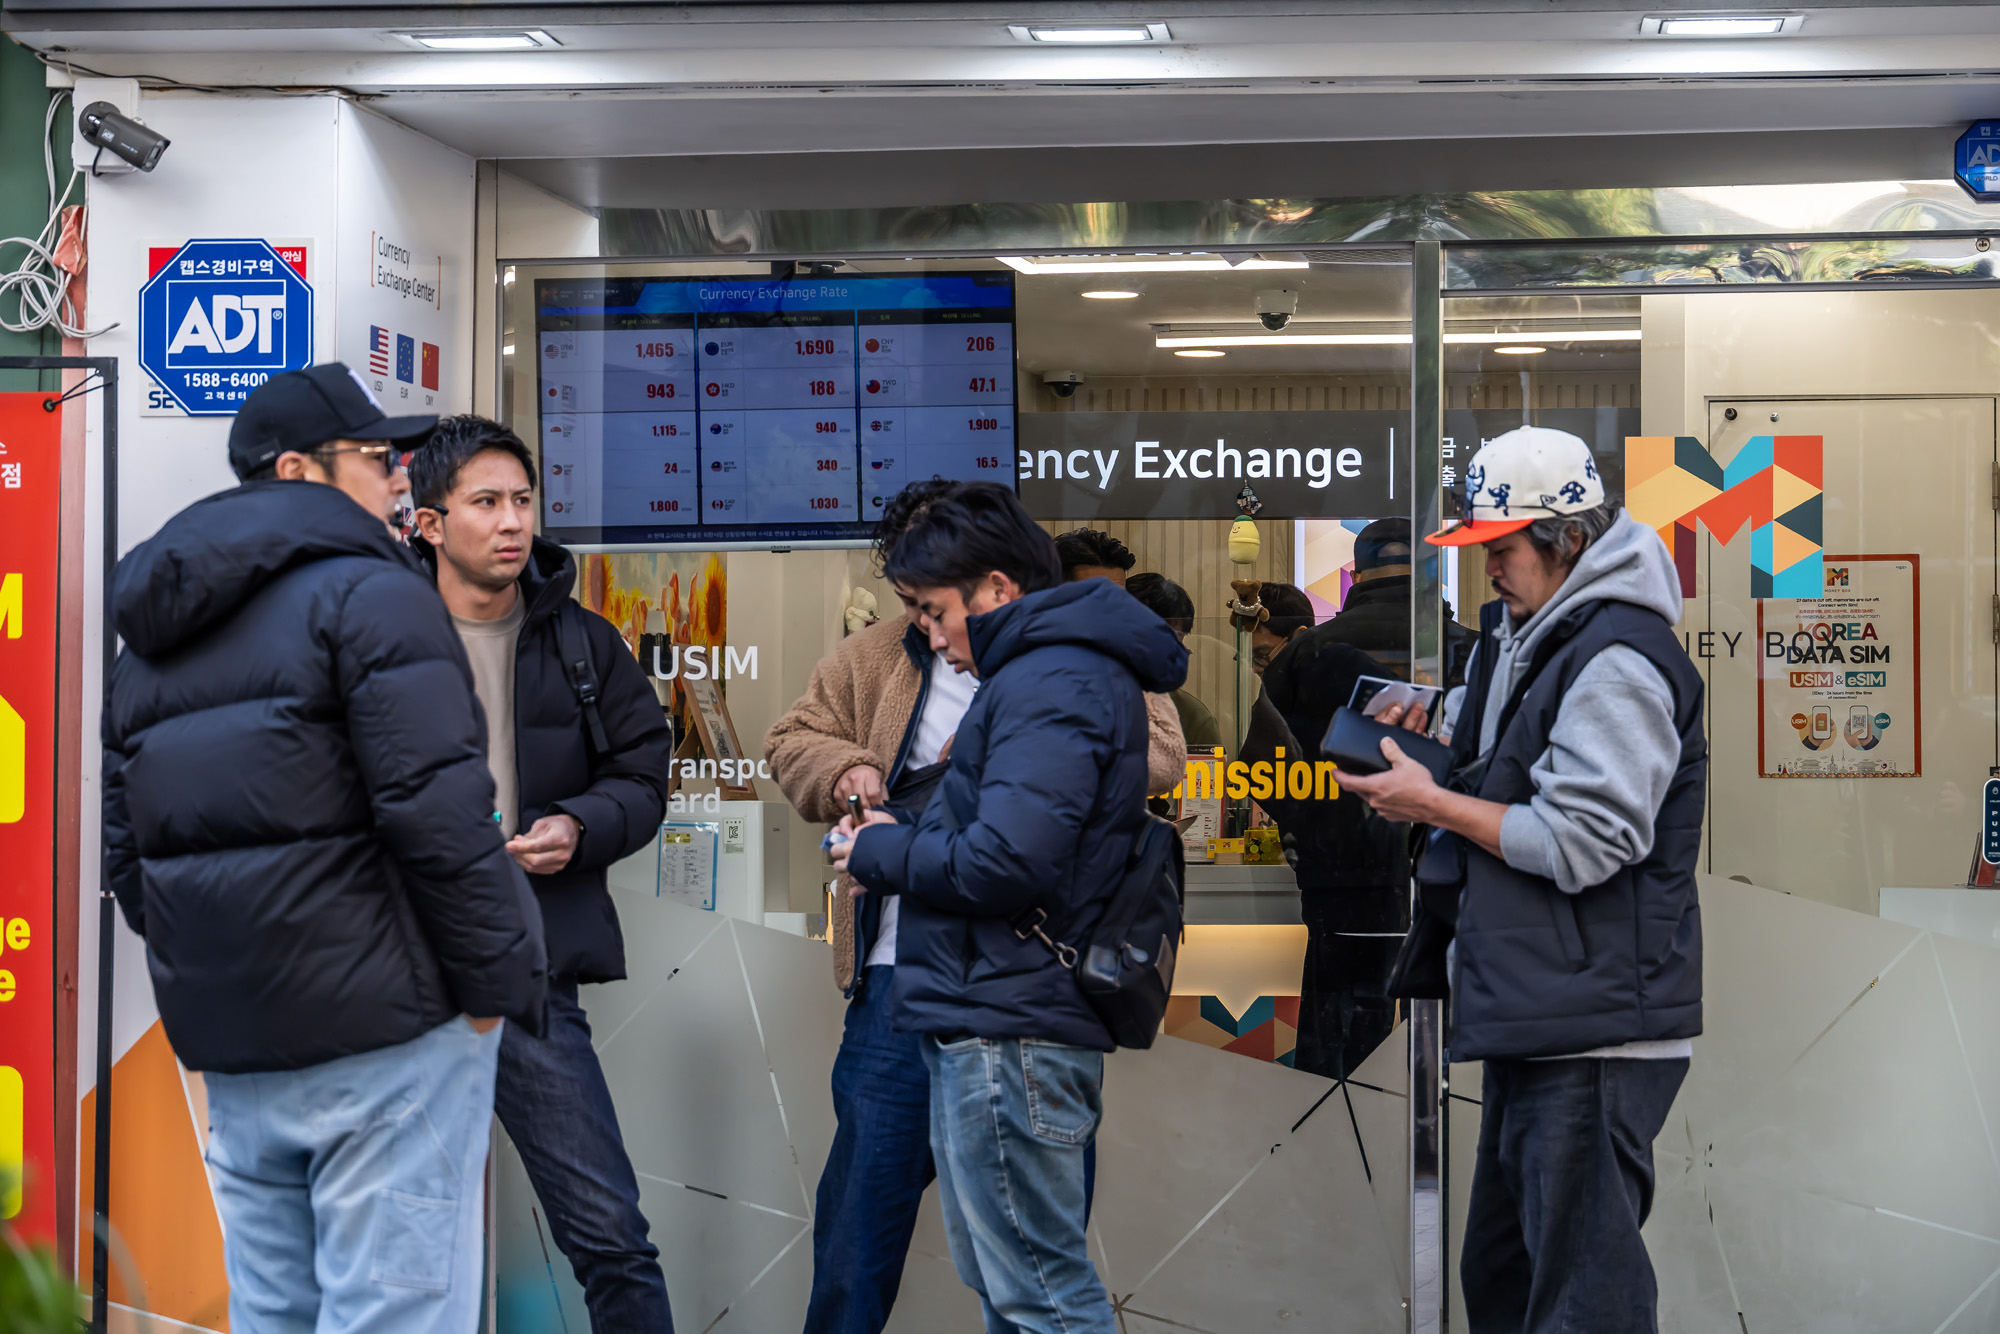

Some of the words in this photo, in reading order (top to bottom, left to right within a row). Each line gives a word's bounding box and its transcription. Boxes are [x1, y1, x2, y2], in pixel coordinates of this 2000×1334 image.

[378, 235, 411, 271] Currency
[180, 259, 274, 275] 캡스경비구역
[377, 264, 412, 299] Exchange
[412, 277, 436, 303] Center
[699, 288, 755, 301] Currency
[758, 287, 817, 301] Exchange
[820, 286, 848, 298] Rate
[168, 294, 285, 354] ADT
[635, 342, 674, 359] 1,465
[795, 339, 835, 356] 1,690
[966, 336, 995, 352] 206
[183, 372, 269, 387] 1588-6400
[374, 380, 384, 392] USD
[969, 377, 996, 392] 47.1
[400, 386, 409, 399] EUR
[646, 383, 675, 398] 943
[809, 380, 835, 396] 188
[148, 390, 176, 409] SE
[425, 394, 434, 406] CNY
[652, 425, 677, 438] 1,115
[815, 421, 837, 433] 940
[968, 418, 998, 431] 1,900
[664, 462, 678, 474] 24
[816, 459, 838, 471] 340
[976, 456, 998, 468] 16.5
[1018, 449, 1120, 490] ency
[1134, 438, 1362, 490] Exchange
[0, 462, 22, 489] 점
[649, 500, 679, 513] 1,800
[809, 497, 839, 511] 1,030
[1798, 622, 1879, 641] KOREA
[1685, 631, 1743, 658] EY
[653, 645, 759, 681] USIM
[1786, 646, 1846, 665] DATA
[1849, 645, 1890, 664] SIM
[1792, 673, 1831, 687] USIM
[1835, 674, 1844, 685] &
[1847, 672, 1884, 686] eSIM
[668, 757, 772, 786] ranspo
[1150, 746, 1340, 800] mission
[669, 787, 721, 814] ard
[1991, 810, 1999, 848] PUSH
[0, 917, 31, 957] e
